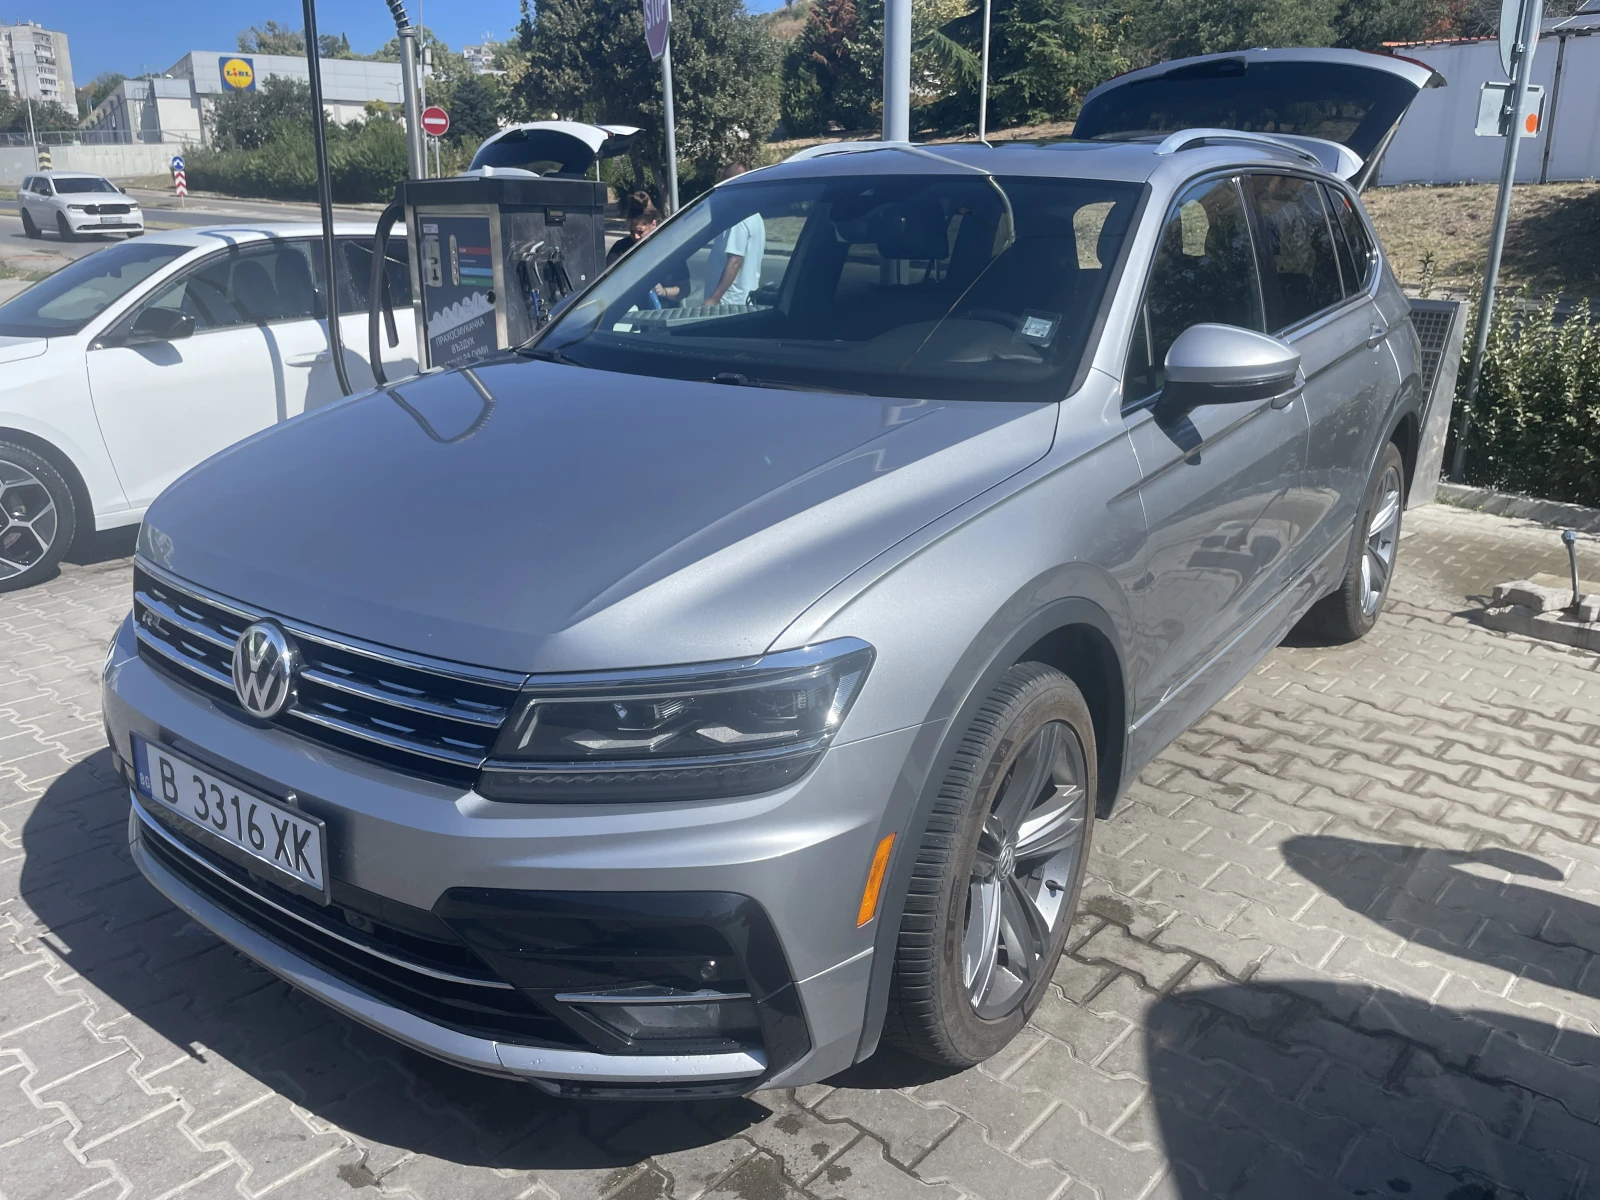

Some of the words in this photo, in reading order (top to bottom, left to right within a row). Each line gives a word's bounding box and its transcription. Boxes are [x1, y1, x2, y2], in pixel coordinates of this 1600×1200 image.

[645, 0, 665, 30] STOP
[435, 317, 486, 347] ПРАХОСМУКАЧКА
[450, 336, 476, 354] ВЪЗДУХ
[139, 772, 151, 789] BG
[159, 756, 179, 805] B
[193, 774, 266, 851] 3316
[271, 812, 316, 880] XK
